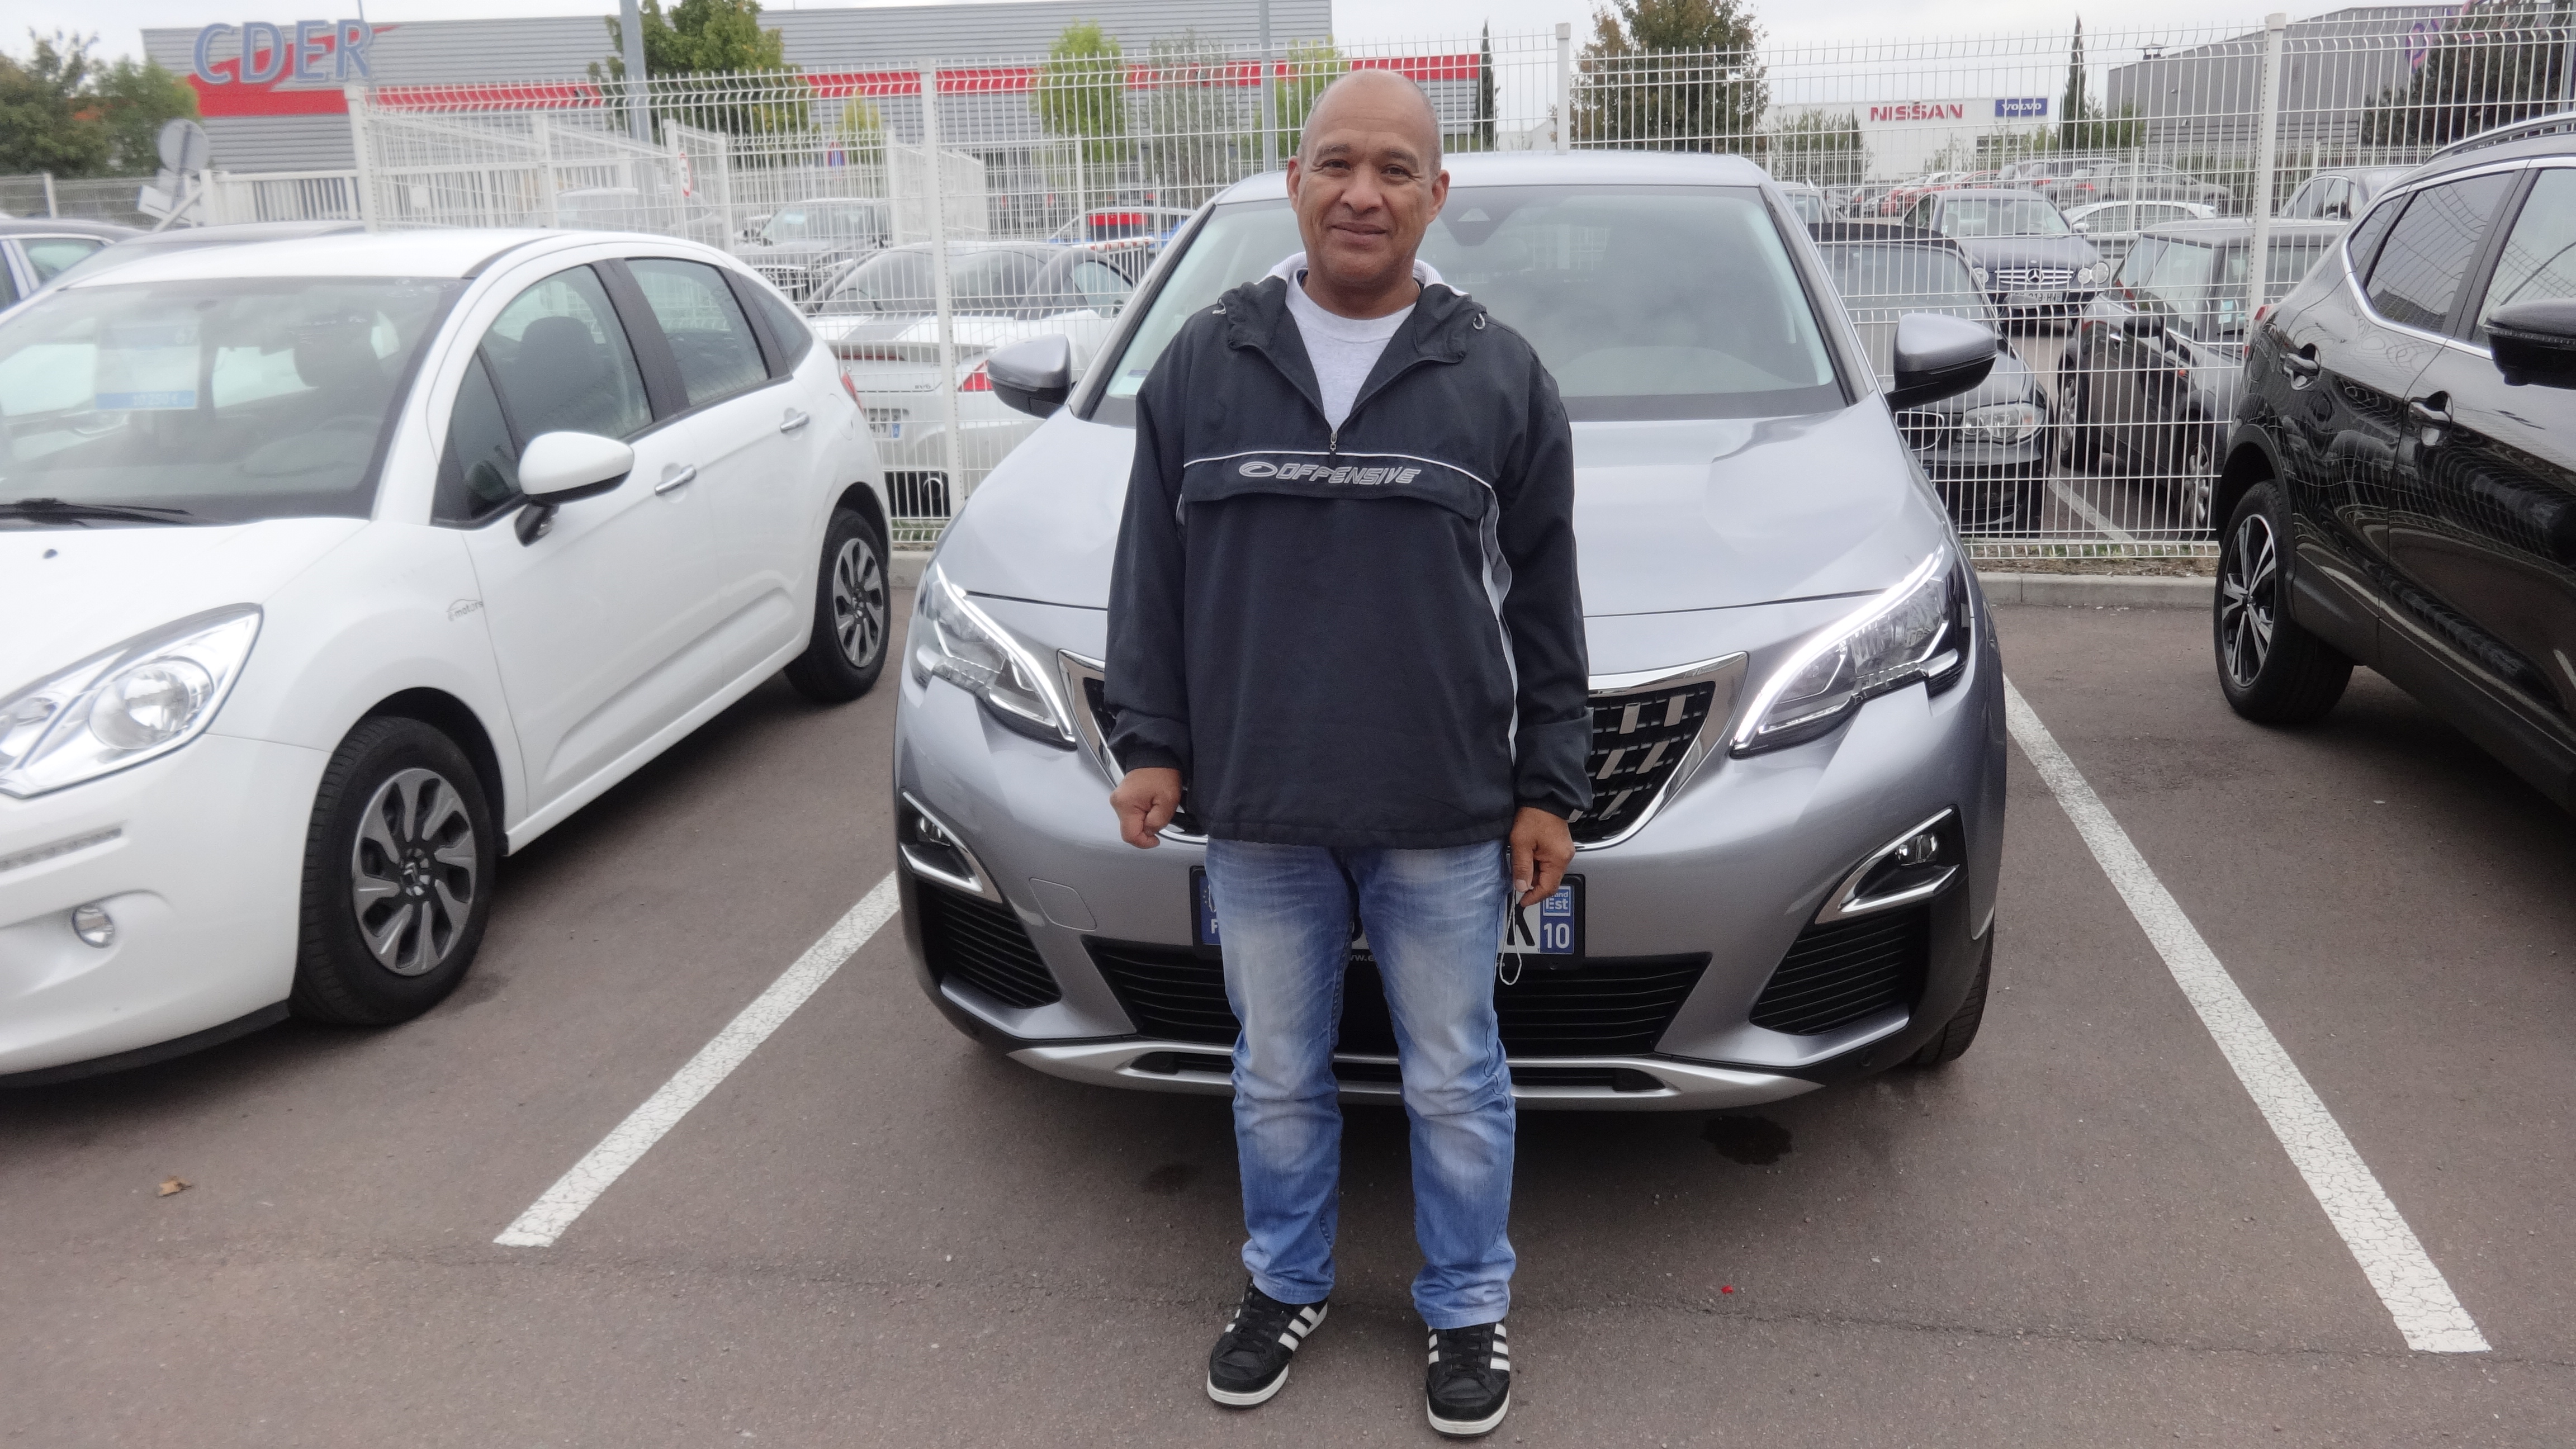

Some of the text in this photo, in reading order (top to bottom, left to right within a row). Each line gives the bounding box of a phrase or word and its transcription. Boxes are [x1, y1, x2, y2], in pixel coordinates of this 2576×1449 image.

[193, 19, 372, 84] CDER
[1871, 104, 1963, 121] NISSAN
[1276, 463, 1422, 485] OFFENSIVE
[1545, 898, 1569, 910] Est
[1211, 918, 1219, 934] F
[1543, 923, 1570, 949] 10
